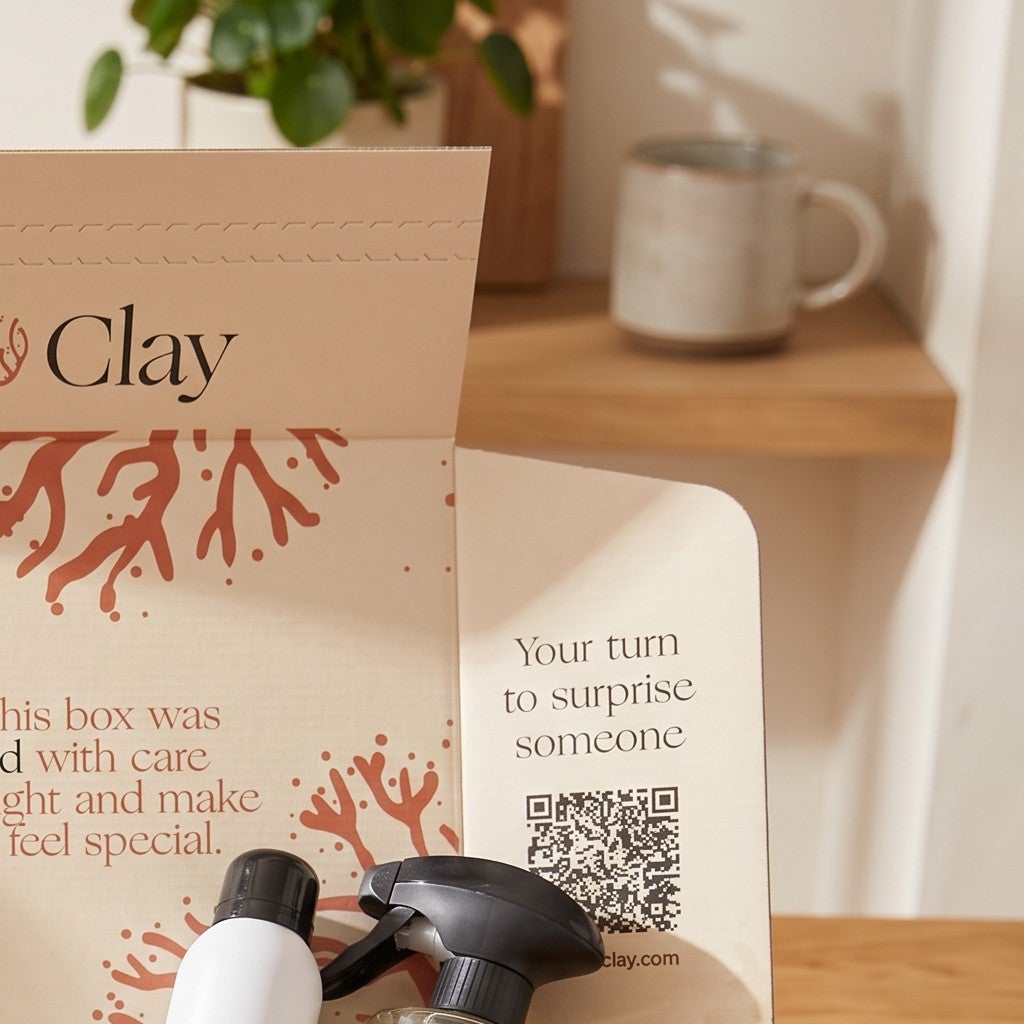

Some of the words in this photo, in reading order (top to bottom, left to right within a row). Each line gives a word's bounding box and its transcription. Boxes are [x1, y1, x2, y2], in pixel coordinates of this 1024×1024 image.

[47, 304, 239, 404] Clay
[514, 636, 594, 667] Your
[606, 633, 680, 661] turn
[65, 696, 135, 731] box
[146, 706, 221, 730] was
[503, 688, 538, 714] to
[552, 674, 696, 718] surprise
[36, 738, 116, 773] with
[131, 748, 212, 773] care
[515, 726, 687, 759] someone
[75, 779, 145, 815] and
[158, 778, 263, 814] make
[8, 822, 71, 857] feel
[85, 820, 223, 868] special.
